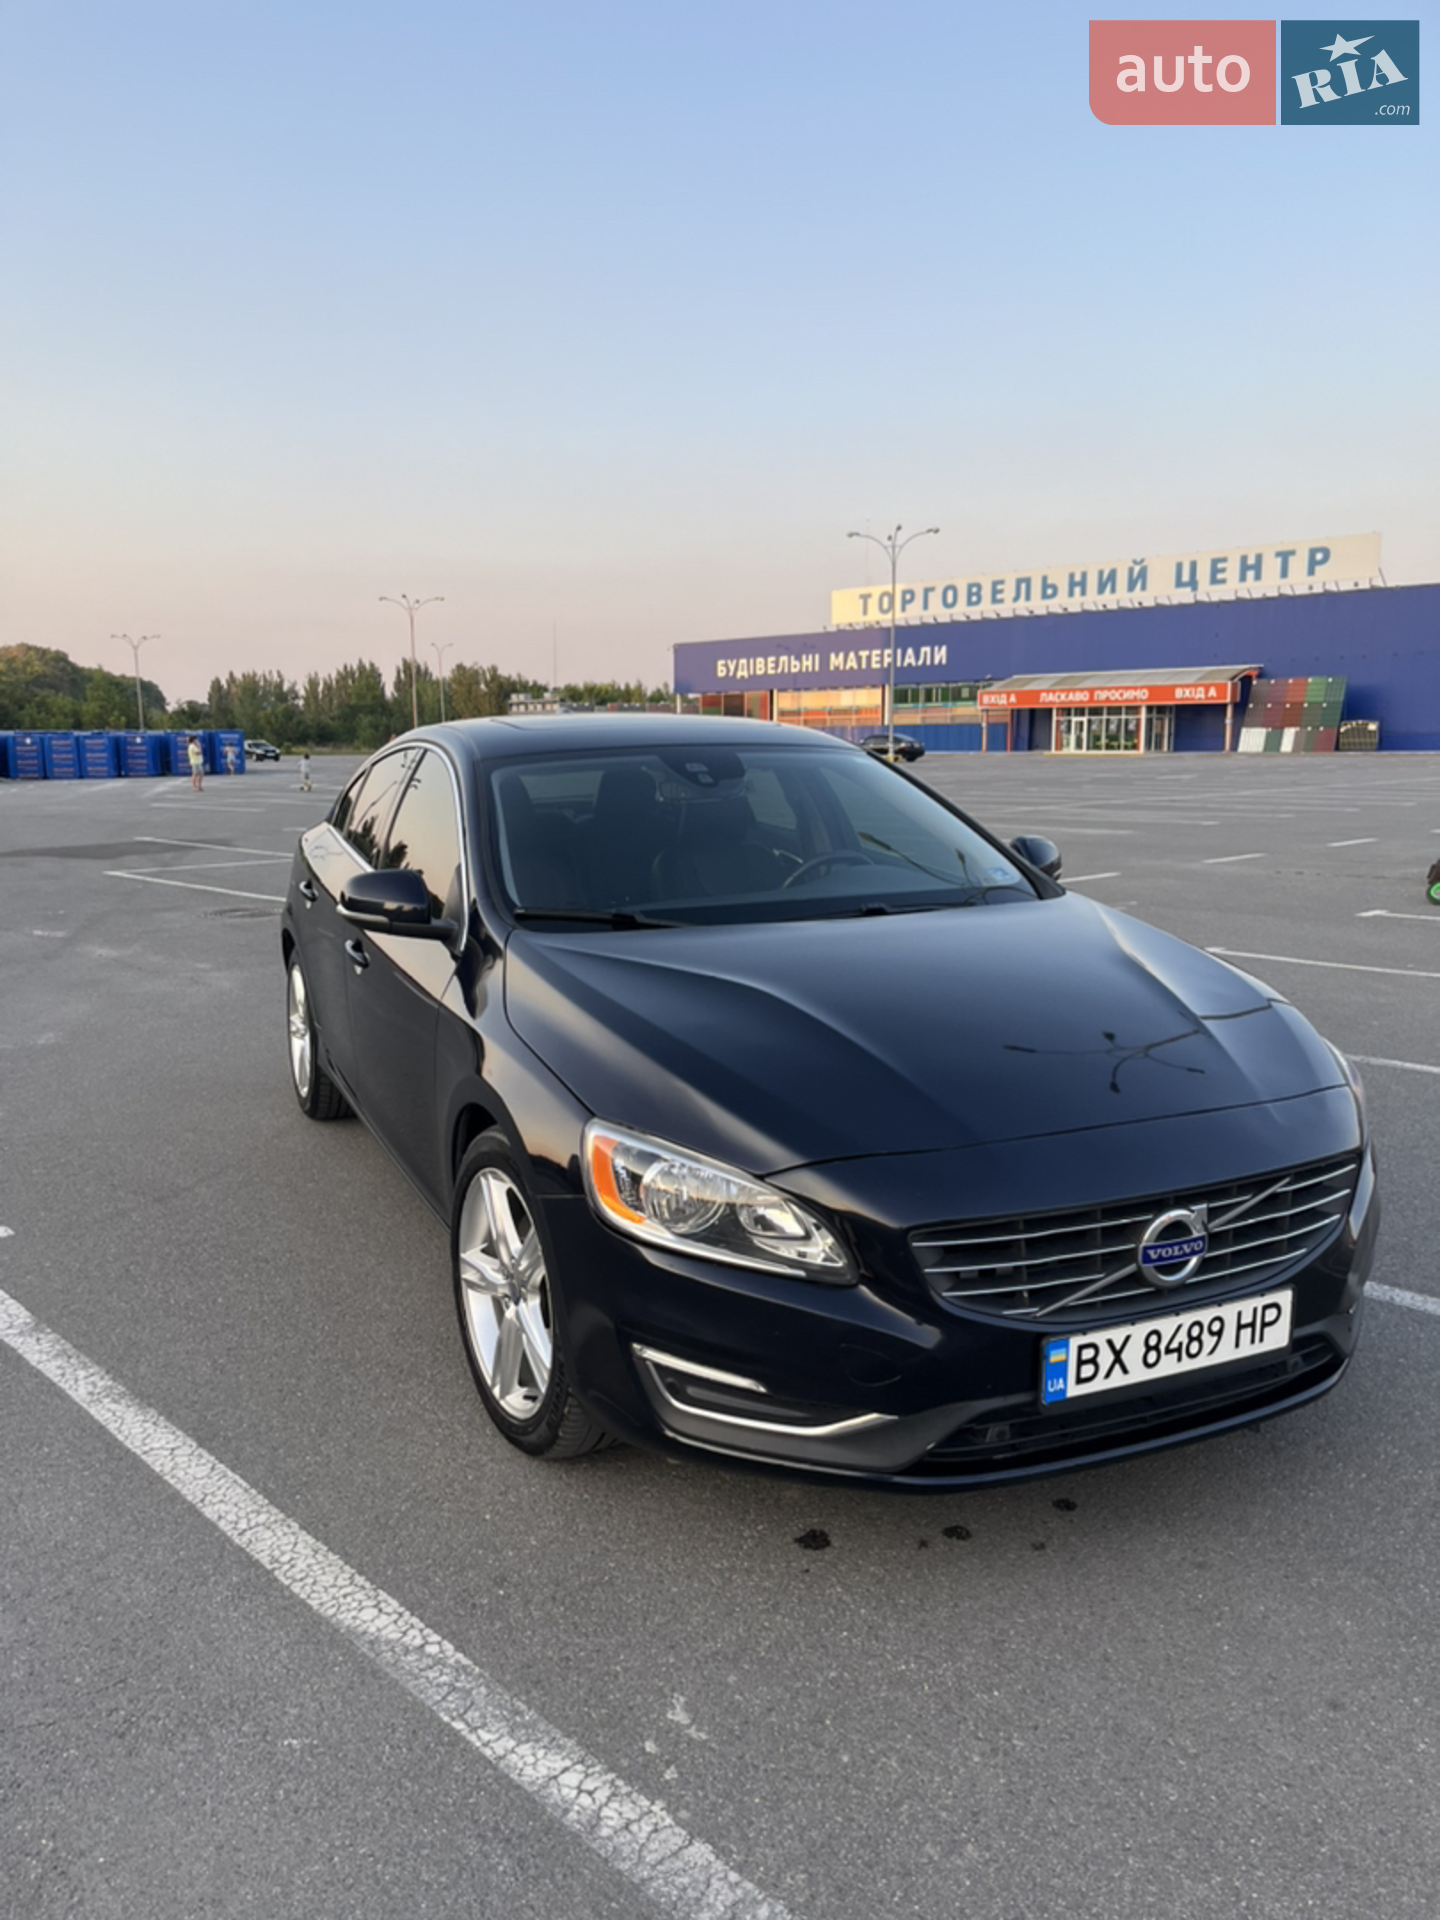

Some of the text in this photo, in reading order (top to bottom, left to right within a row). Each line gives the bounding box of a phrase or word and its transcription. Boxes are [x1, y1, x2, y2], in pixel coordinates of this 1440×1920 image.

[859, 546, 1331, 616] ТОРГОВЕЛЬНИЙ ЦЕНТР
[716, 645, 947, 680] БУДІВЕЛЬНІ МАТЕРІАЛИ
[982, 693, 1007, 706] ВХІД
[1039, 688, 1149, 704] ЛАСКАВО ПРОСИМО
[1174, 687, 1206, 700] ВХІД
[1146, 1240, 1204, 1260] VOLVO
[1075, 1301, 1282, 1385] BX 8489 HP
[1047, 1377, 1065, 1393] UA
